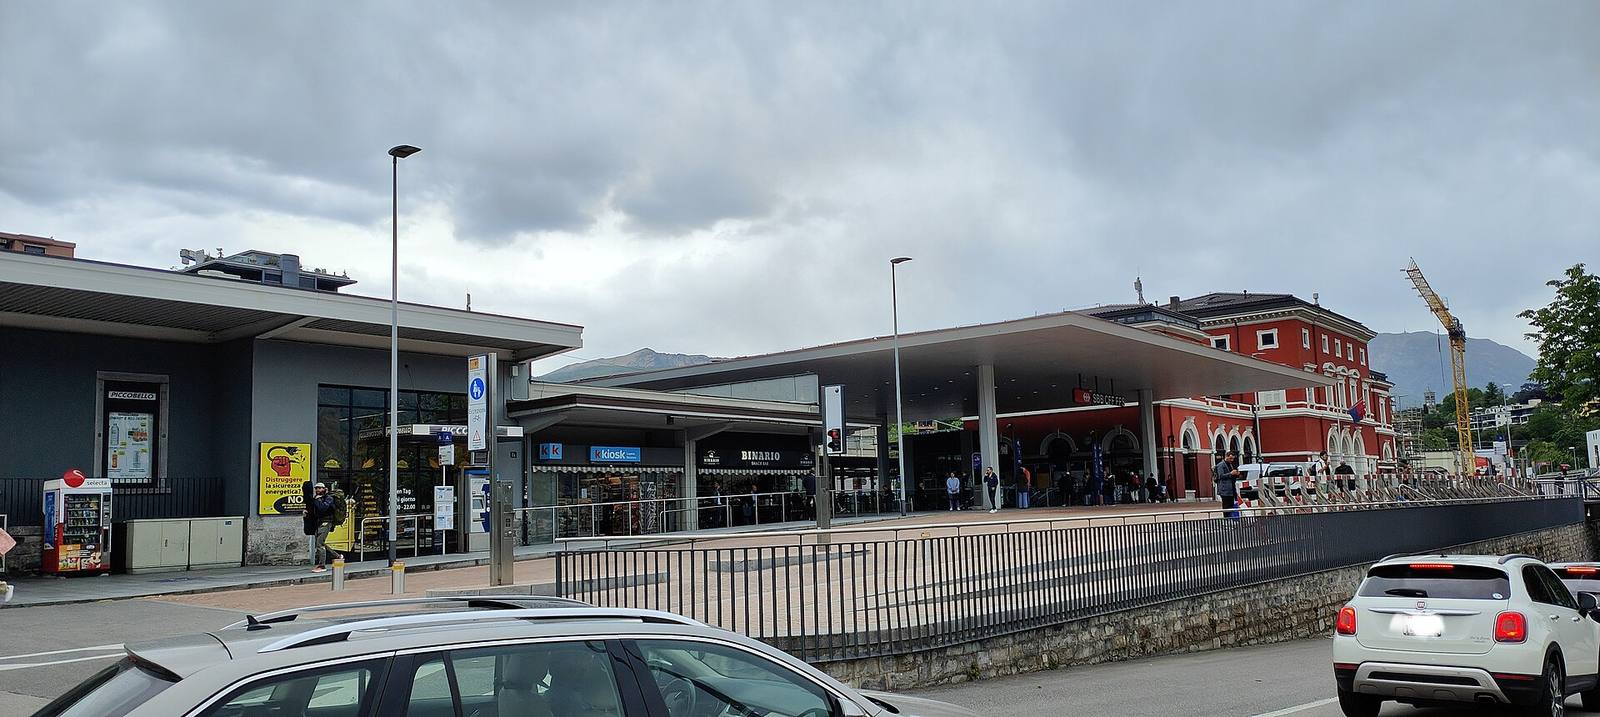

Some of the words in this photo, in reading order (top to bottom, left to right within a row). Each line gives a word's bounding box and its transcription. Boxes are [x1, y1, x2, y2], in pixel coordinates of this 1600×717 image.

[110, 391, 153, 400] PICCOBELLO
[1092, 393, 1104, 404] SBB
[741, 450, 780, 460] BINARIO
